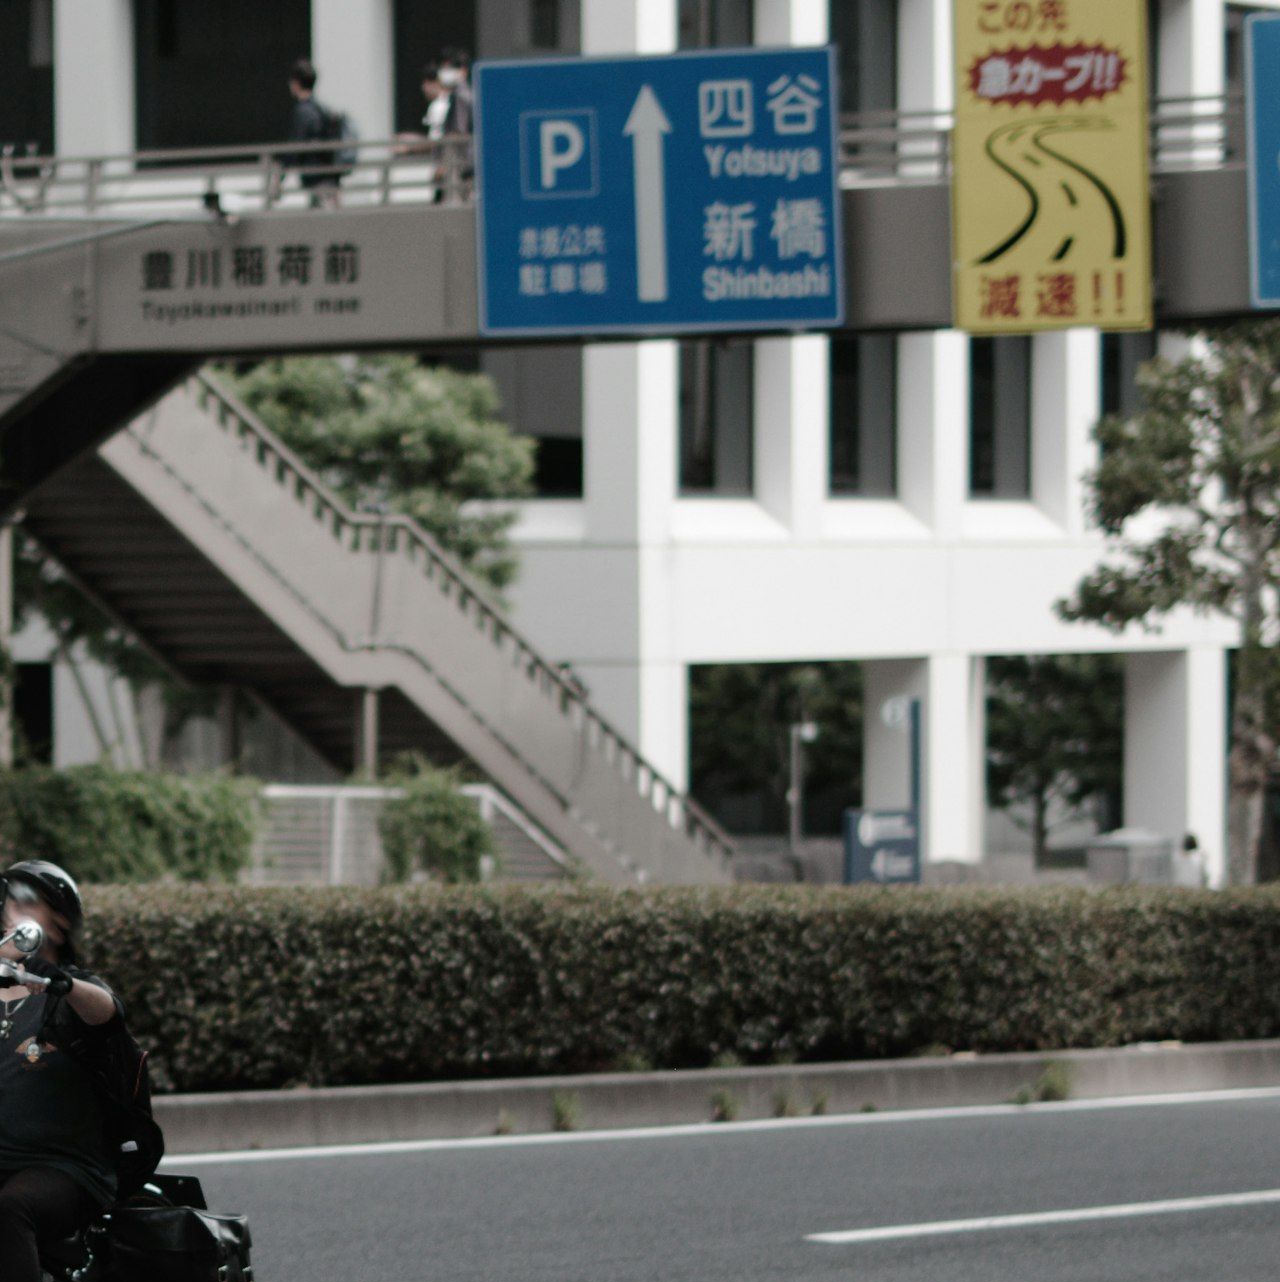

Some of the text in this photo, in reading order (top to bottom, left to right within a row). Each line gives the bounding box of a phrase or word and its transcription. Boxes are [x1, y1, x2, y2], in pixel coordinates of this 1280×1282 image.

[977, 0, 1067, 33] この先
[698, 74, 823, 138] 四谷
[540, 120, 584, 189] P
[703, 144, 821, 181] Yotsuya
[703, 197, 826, 262] 新橋
[702, 262, 831, 301] Shinbashi
